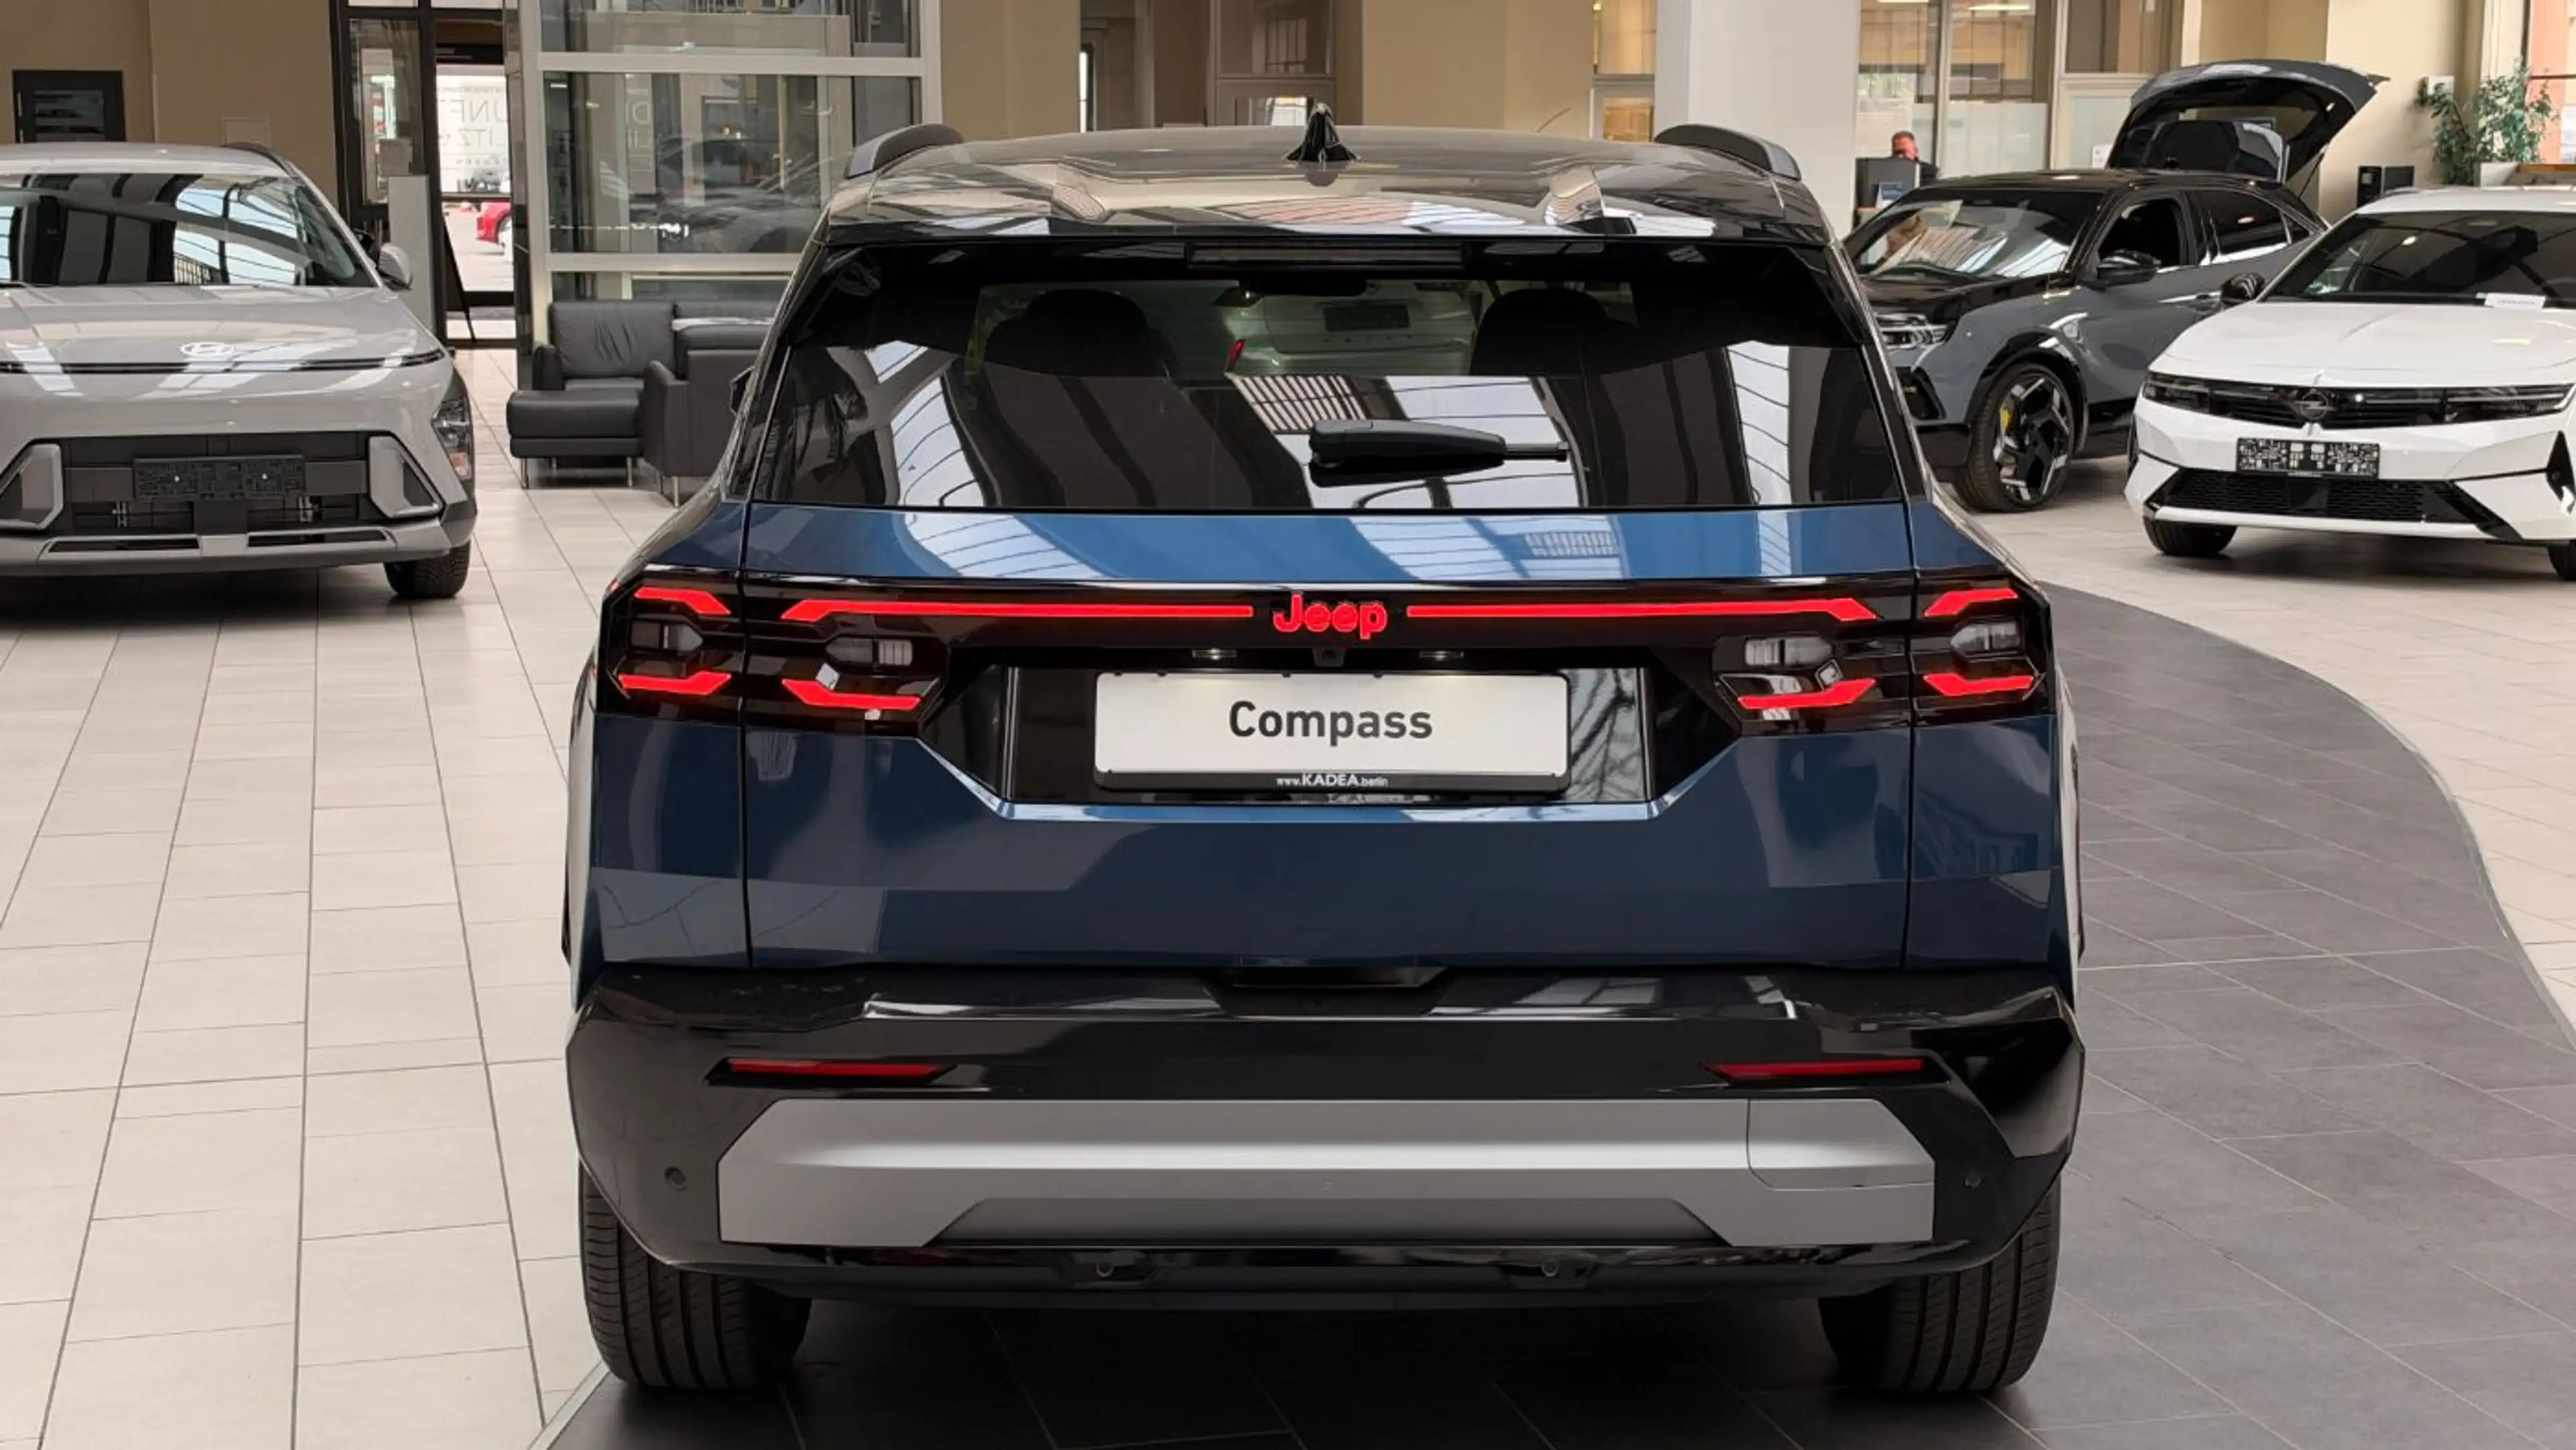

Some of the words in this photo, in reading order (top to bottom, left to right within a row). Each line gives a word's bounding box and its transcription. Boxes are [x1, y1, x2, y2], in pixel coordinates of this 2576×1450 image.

[1273, 593, 1388, 640] Jeep
[1229, 701, 1433, 747] Compass
[1275, 773, 1389, 787] www.KADEA.berlin
